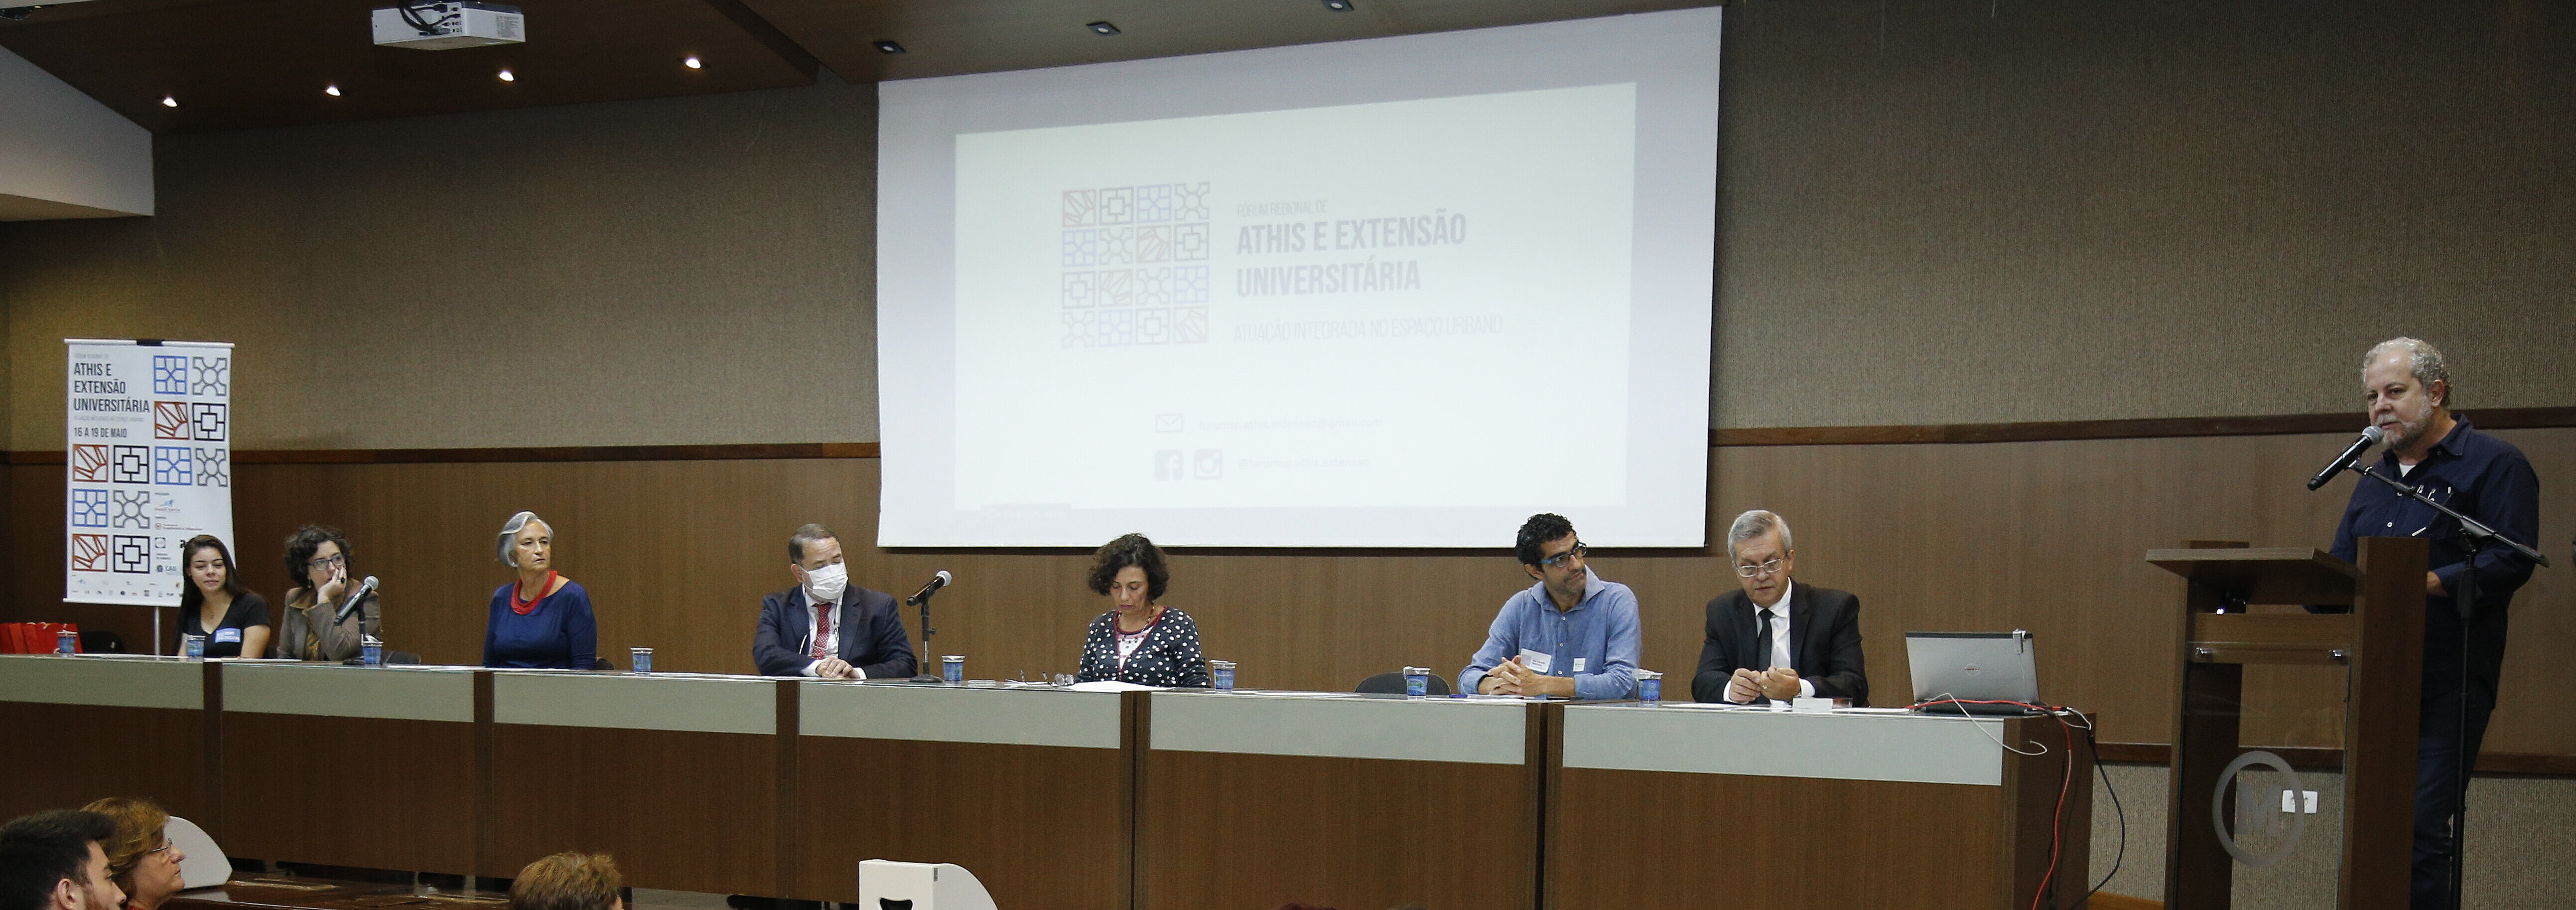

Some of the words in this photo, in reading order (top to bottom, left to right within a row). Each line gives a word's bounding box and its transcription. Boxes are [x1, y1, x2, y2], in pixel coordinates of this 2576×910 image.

[1236, 201, 1268, 217] FÓRUM
[1270, 200, 1314, 215] REGIONAL
[1316, 199, 1328, 213] DE
[1236, 223, 1306, 254] ATHIS
[1314, 221, 1328, 251] E
[1335, 208, 1467, 250] EXTENSÃO
[1236, 256, 1421, 298] UNIVERSITÁRIA
[1234, 320, 1291, 343] ATUAÇÃO
[1294, 319, 1366, 340] INTEGRADA
[1370, 319, 1388, 338] NO
[1391, 316, 1442, 338] ESPAÇO
[1446, 314, 1503, 335] URBANO
[74, 363, 103, 376] ATHIS
[106, 363, 112, 376] E
[74, 379, 126, 394] EXTENSÃO
[74, 396, 149, 412] UNIVERSITÁRIA
[74, 427, 83, 437] 16
[84, 428, 89, 437] A
[92, 428, 99, 437] 19
[101, 428, 109, 438] DE
[111, 428, 128, 438] MAIO
